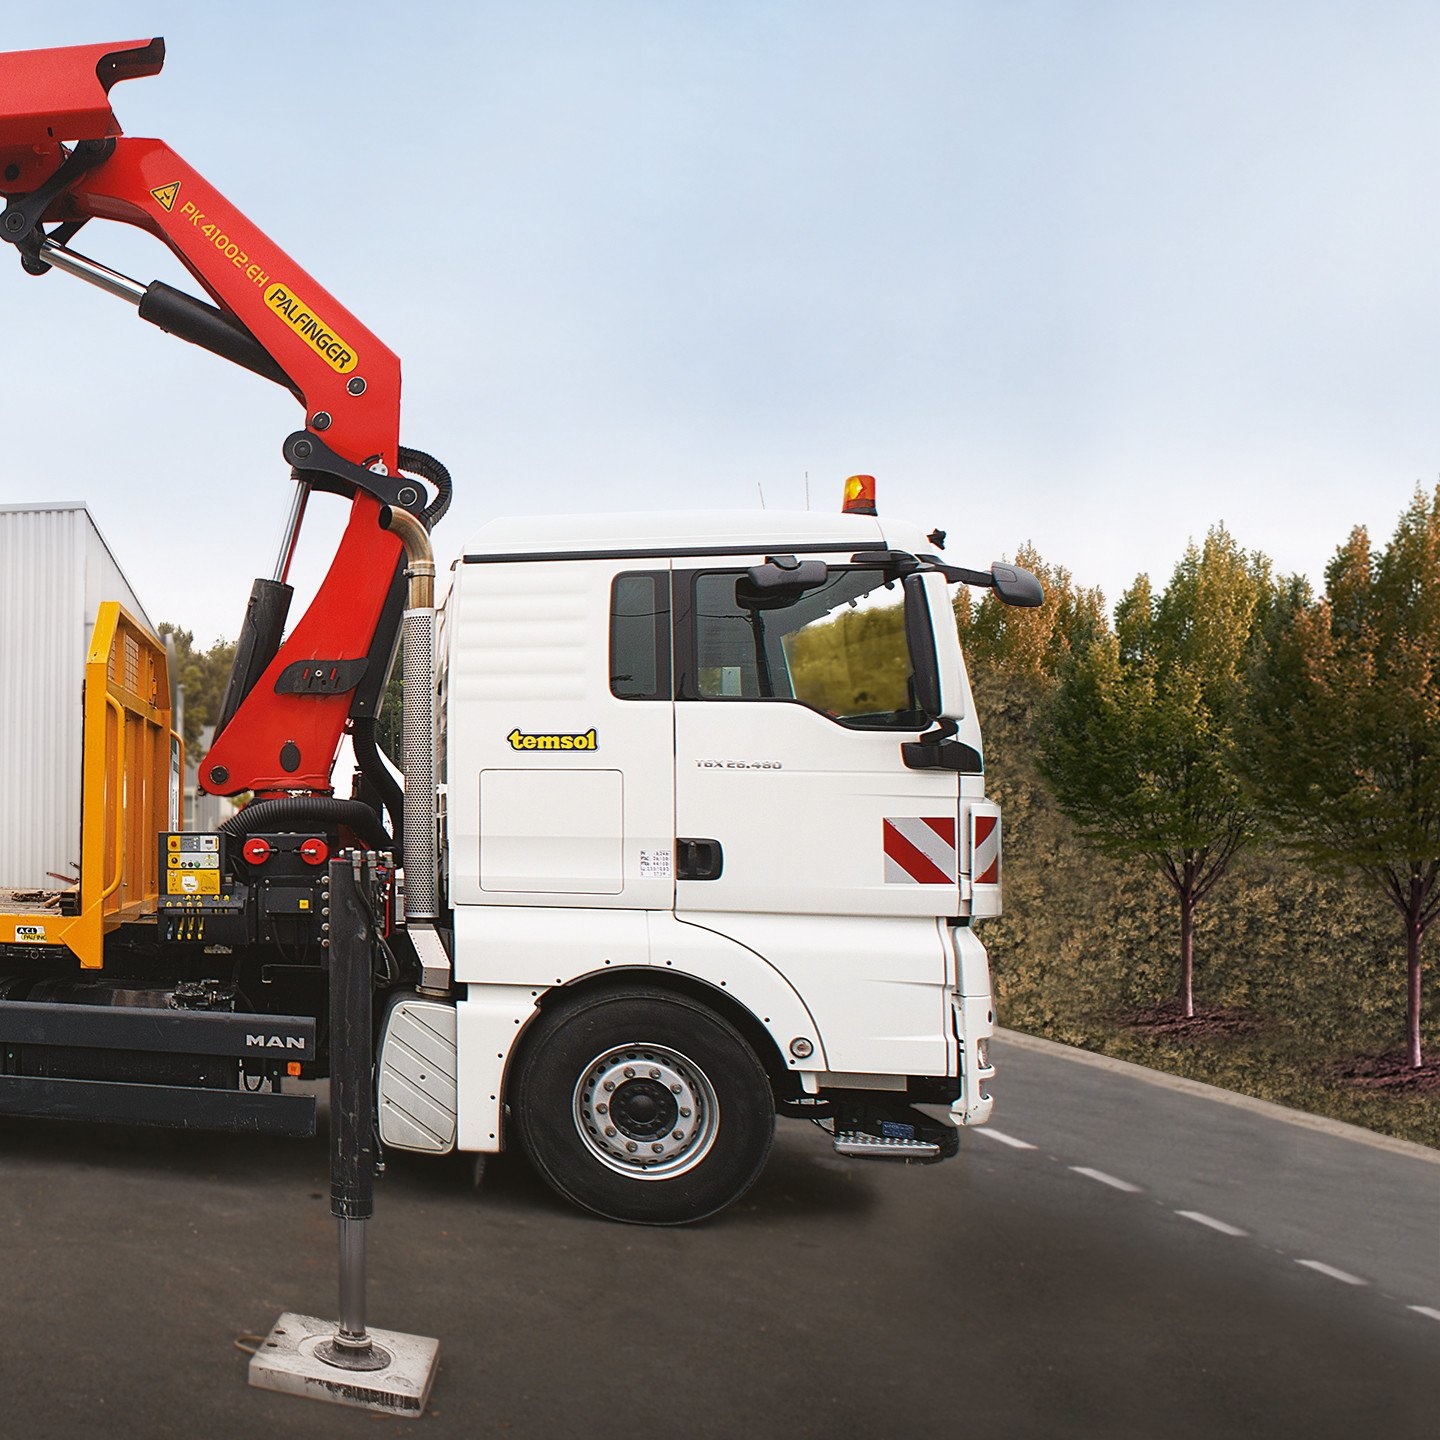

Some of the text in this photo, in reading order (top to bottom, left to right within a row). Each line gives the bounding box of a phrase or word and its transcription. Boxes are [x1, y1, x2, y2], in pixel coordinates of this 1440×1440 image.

[180, 201, 205, 226] PK
[268, 288, 352, 369] PALFINGER
[508, 730, 596, 749] temsol
[245, 1034, 305, 1049] MAN
